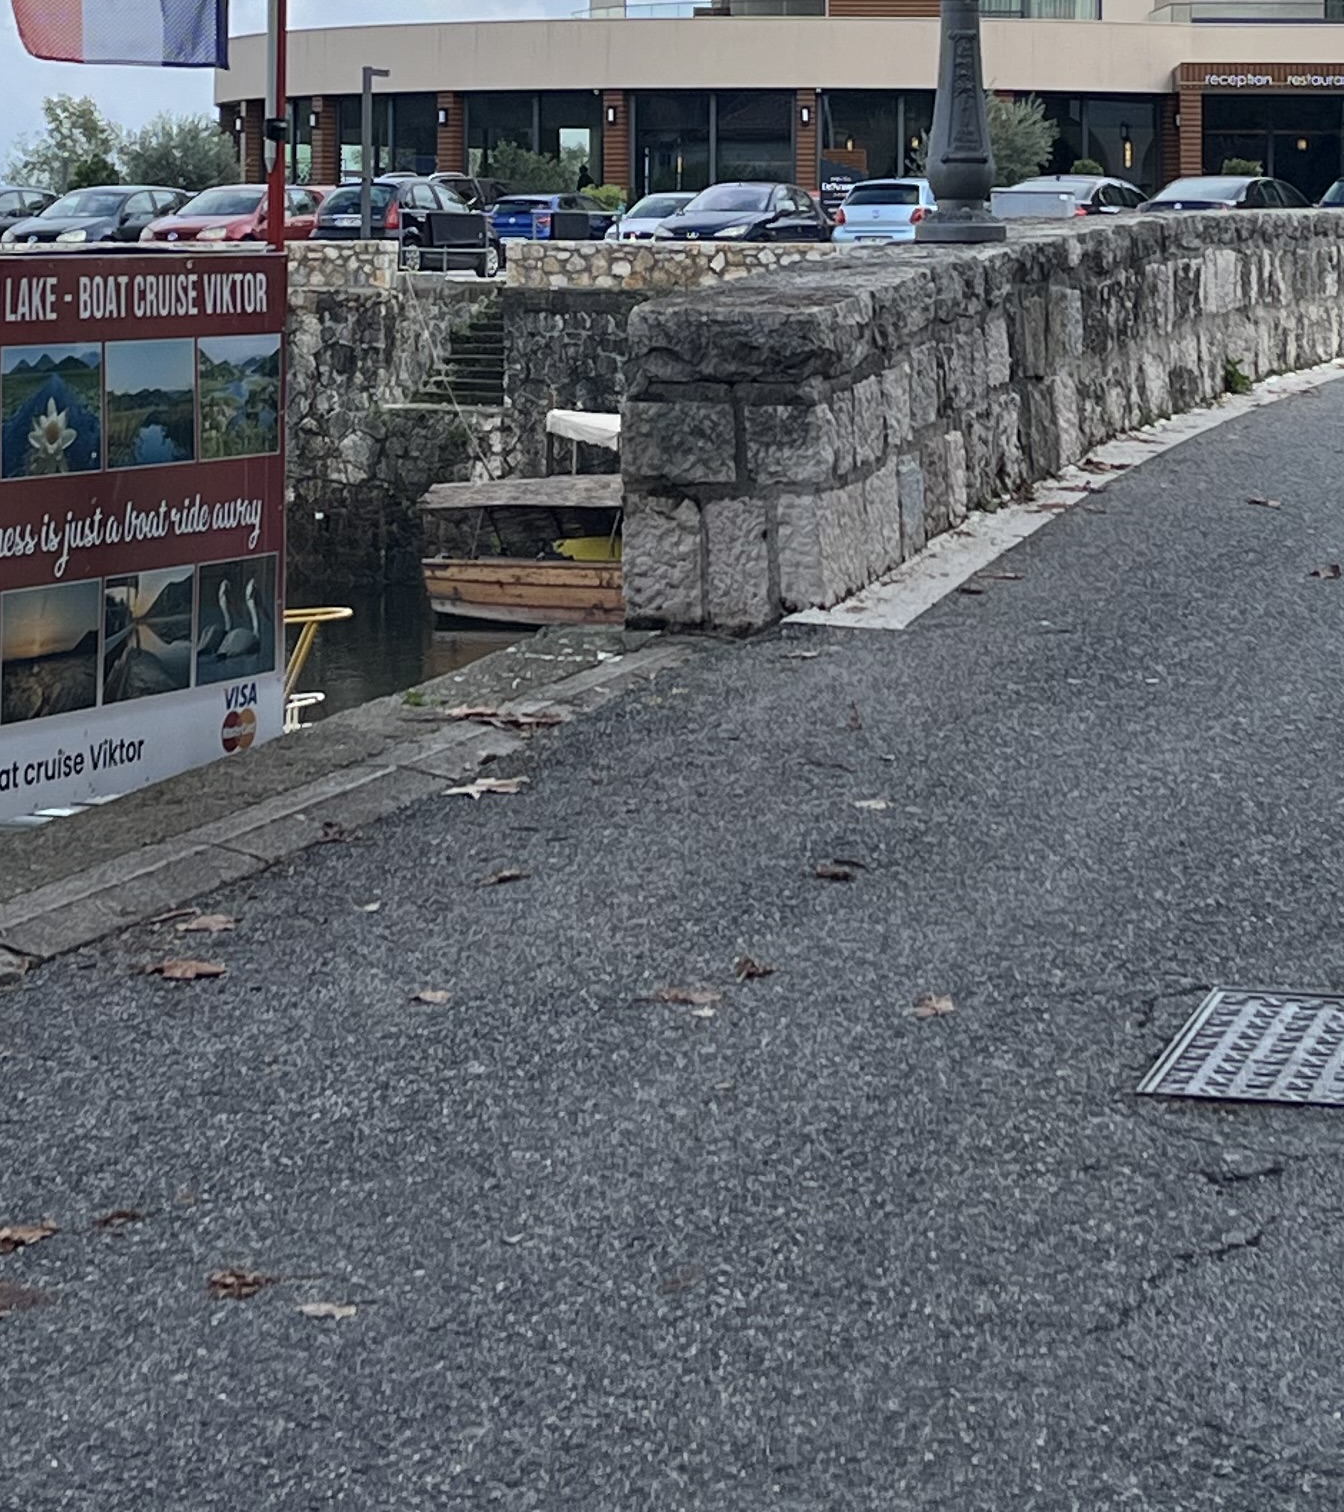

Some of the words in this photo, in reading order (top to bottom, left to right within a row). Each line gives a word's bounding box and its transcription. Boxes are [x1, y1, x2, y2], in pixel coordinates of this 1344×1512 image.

[1205, 73, 1273, 87] reception
[5, 276, 58, 323] LAKE
[78, 275, 129, 320] BOAT
[133, 273, 198, 318] CRUISE
[204, 272, 268, 315] VIKTOR
[41, 514, 60, 553] is
[54, 506, 104, 578] just
[106, 519, 121, 544] a
[124, 499, 168, 541] boat
[169, 493, 209, 535] ride
[211, 497, 263, 550] away
[224, 682, 257, 710] VISA
[24, 749, 84, 785] cruise
[90, 738, 145, 770] Viktor
